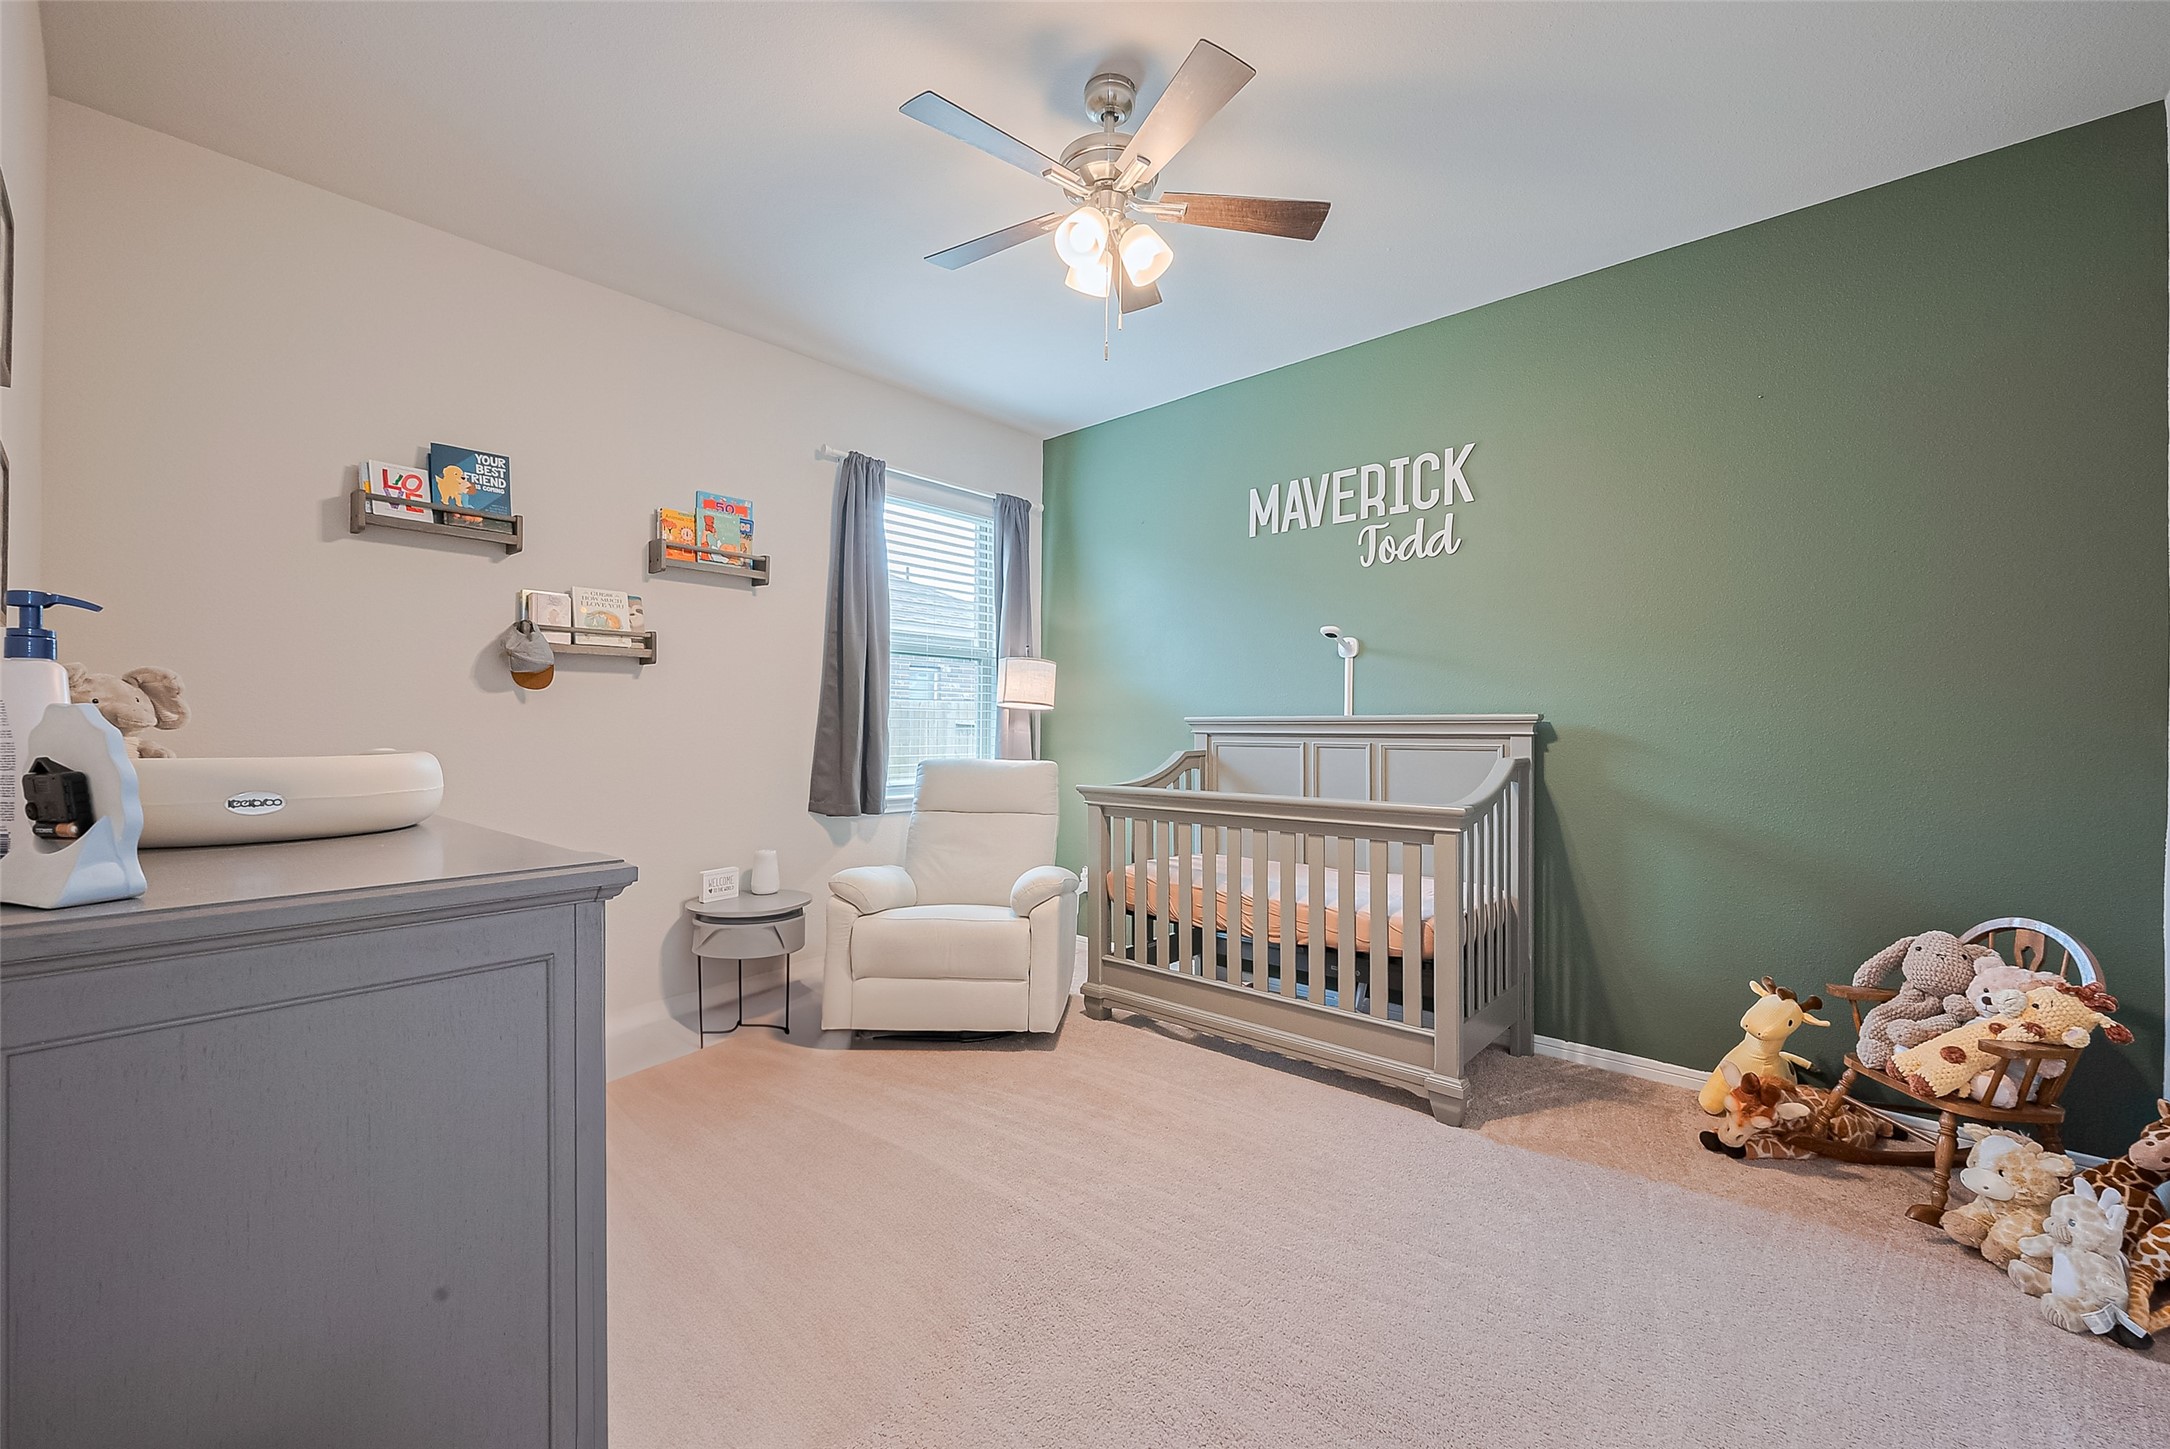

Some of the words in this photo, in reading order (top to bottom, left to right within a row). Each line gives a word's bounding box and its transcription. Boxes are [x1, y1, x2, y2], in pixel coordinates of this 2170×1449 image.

[474, 453, 506, 468] YOUR
[475, 464, 507, 478] BEST
[464, 471, 507, 488] FRIEND
[1248, 442, 1476, 538] MAVERICK
[715, 502, 735, 514] 50
[1357, 512, 1462, 568] Todd
[708, 875, 734, 887] WELCOME
